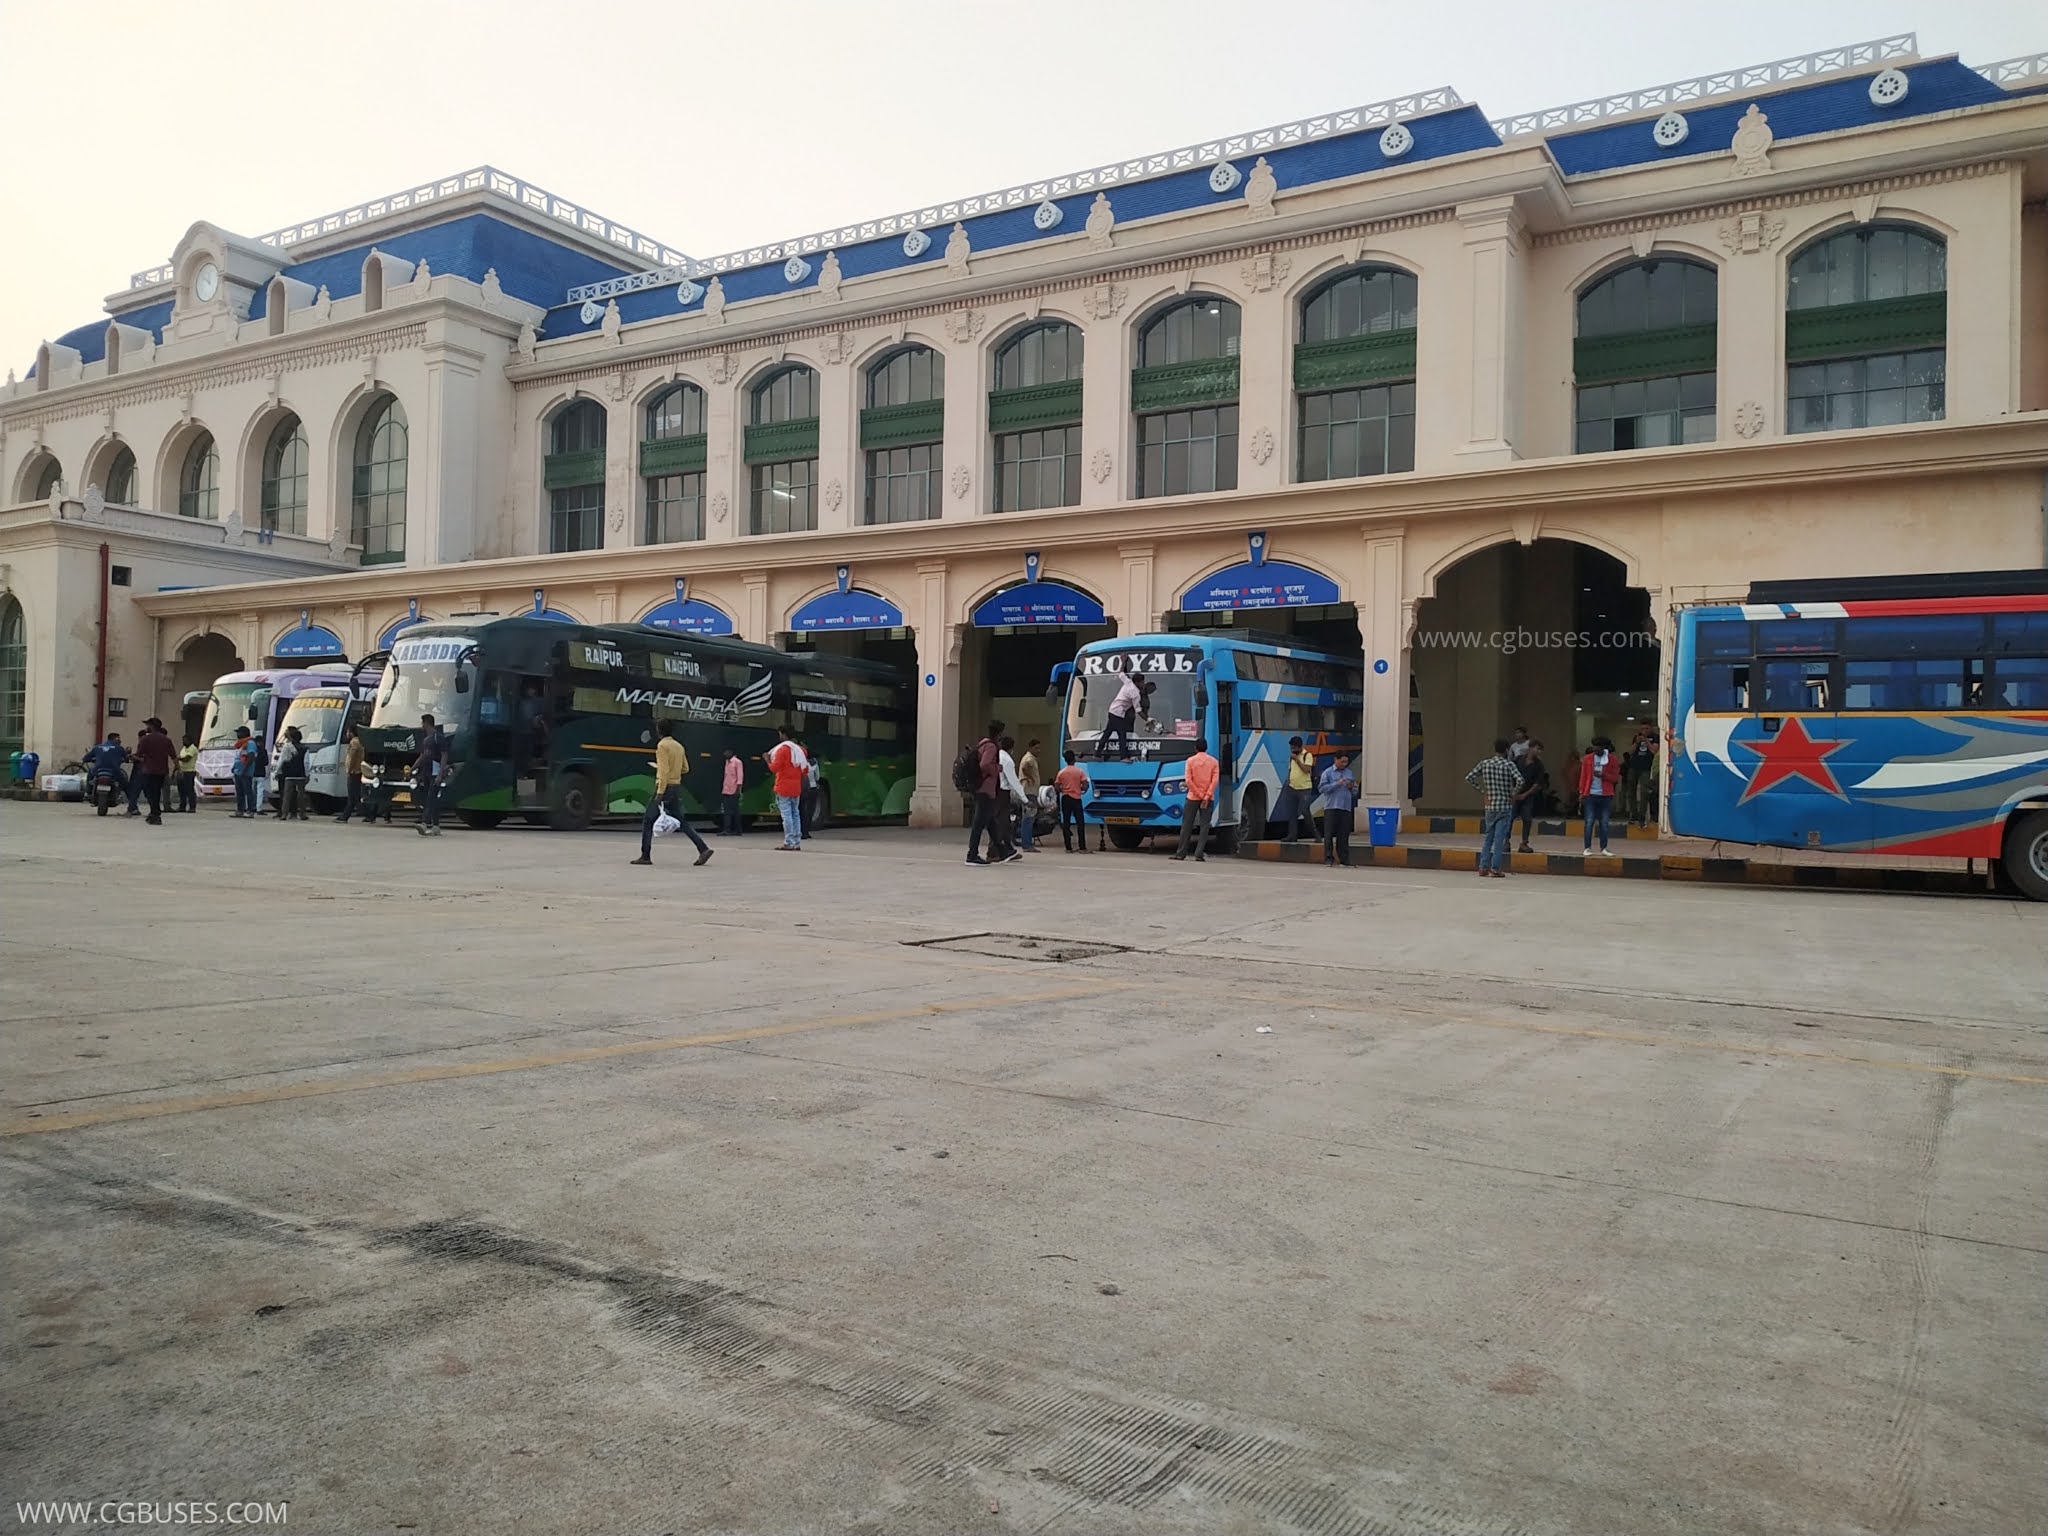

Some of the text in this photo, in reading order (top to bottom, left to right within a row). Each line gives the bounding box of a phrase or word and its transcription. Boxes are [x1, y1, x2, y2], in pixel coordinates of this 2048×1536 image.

[584, 646, 623, 668] RAIPUR
[664, 658, 700, 677] NAGPUR
[1084, 653, 1193, 675] ROYAL
[615, 687, 739, 715] MAHENDRA
[687, 710, 740, 723] TRAVELS
